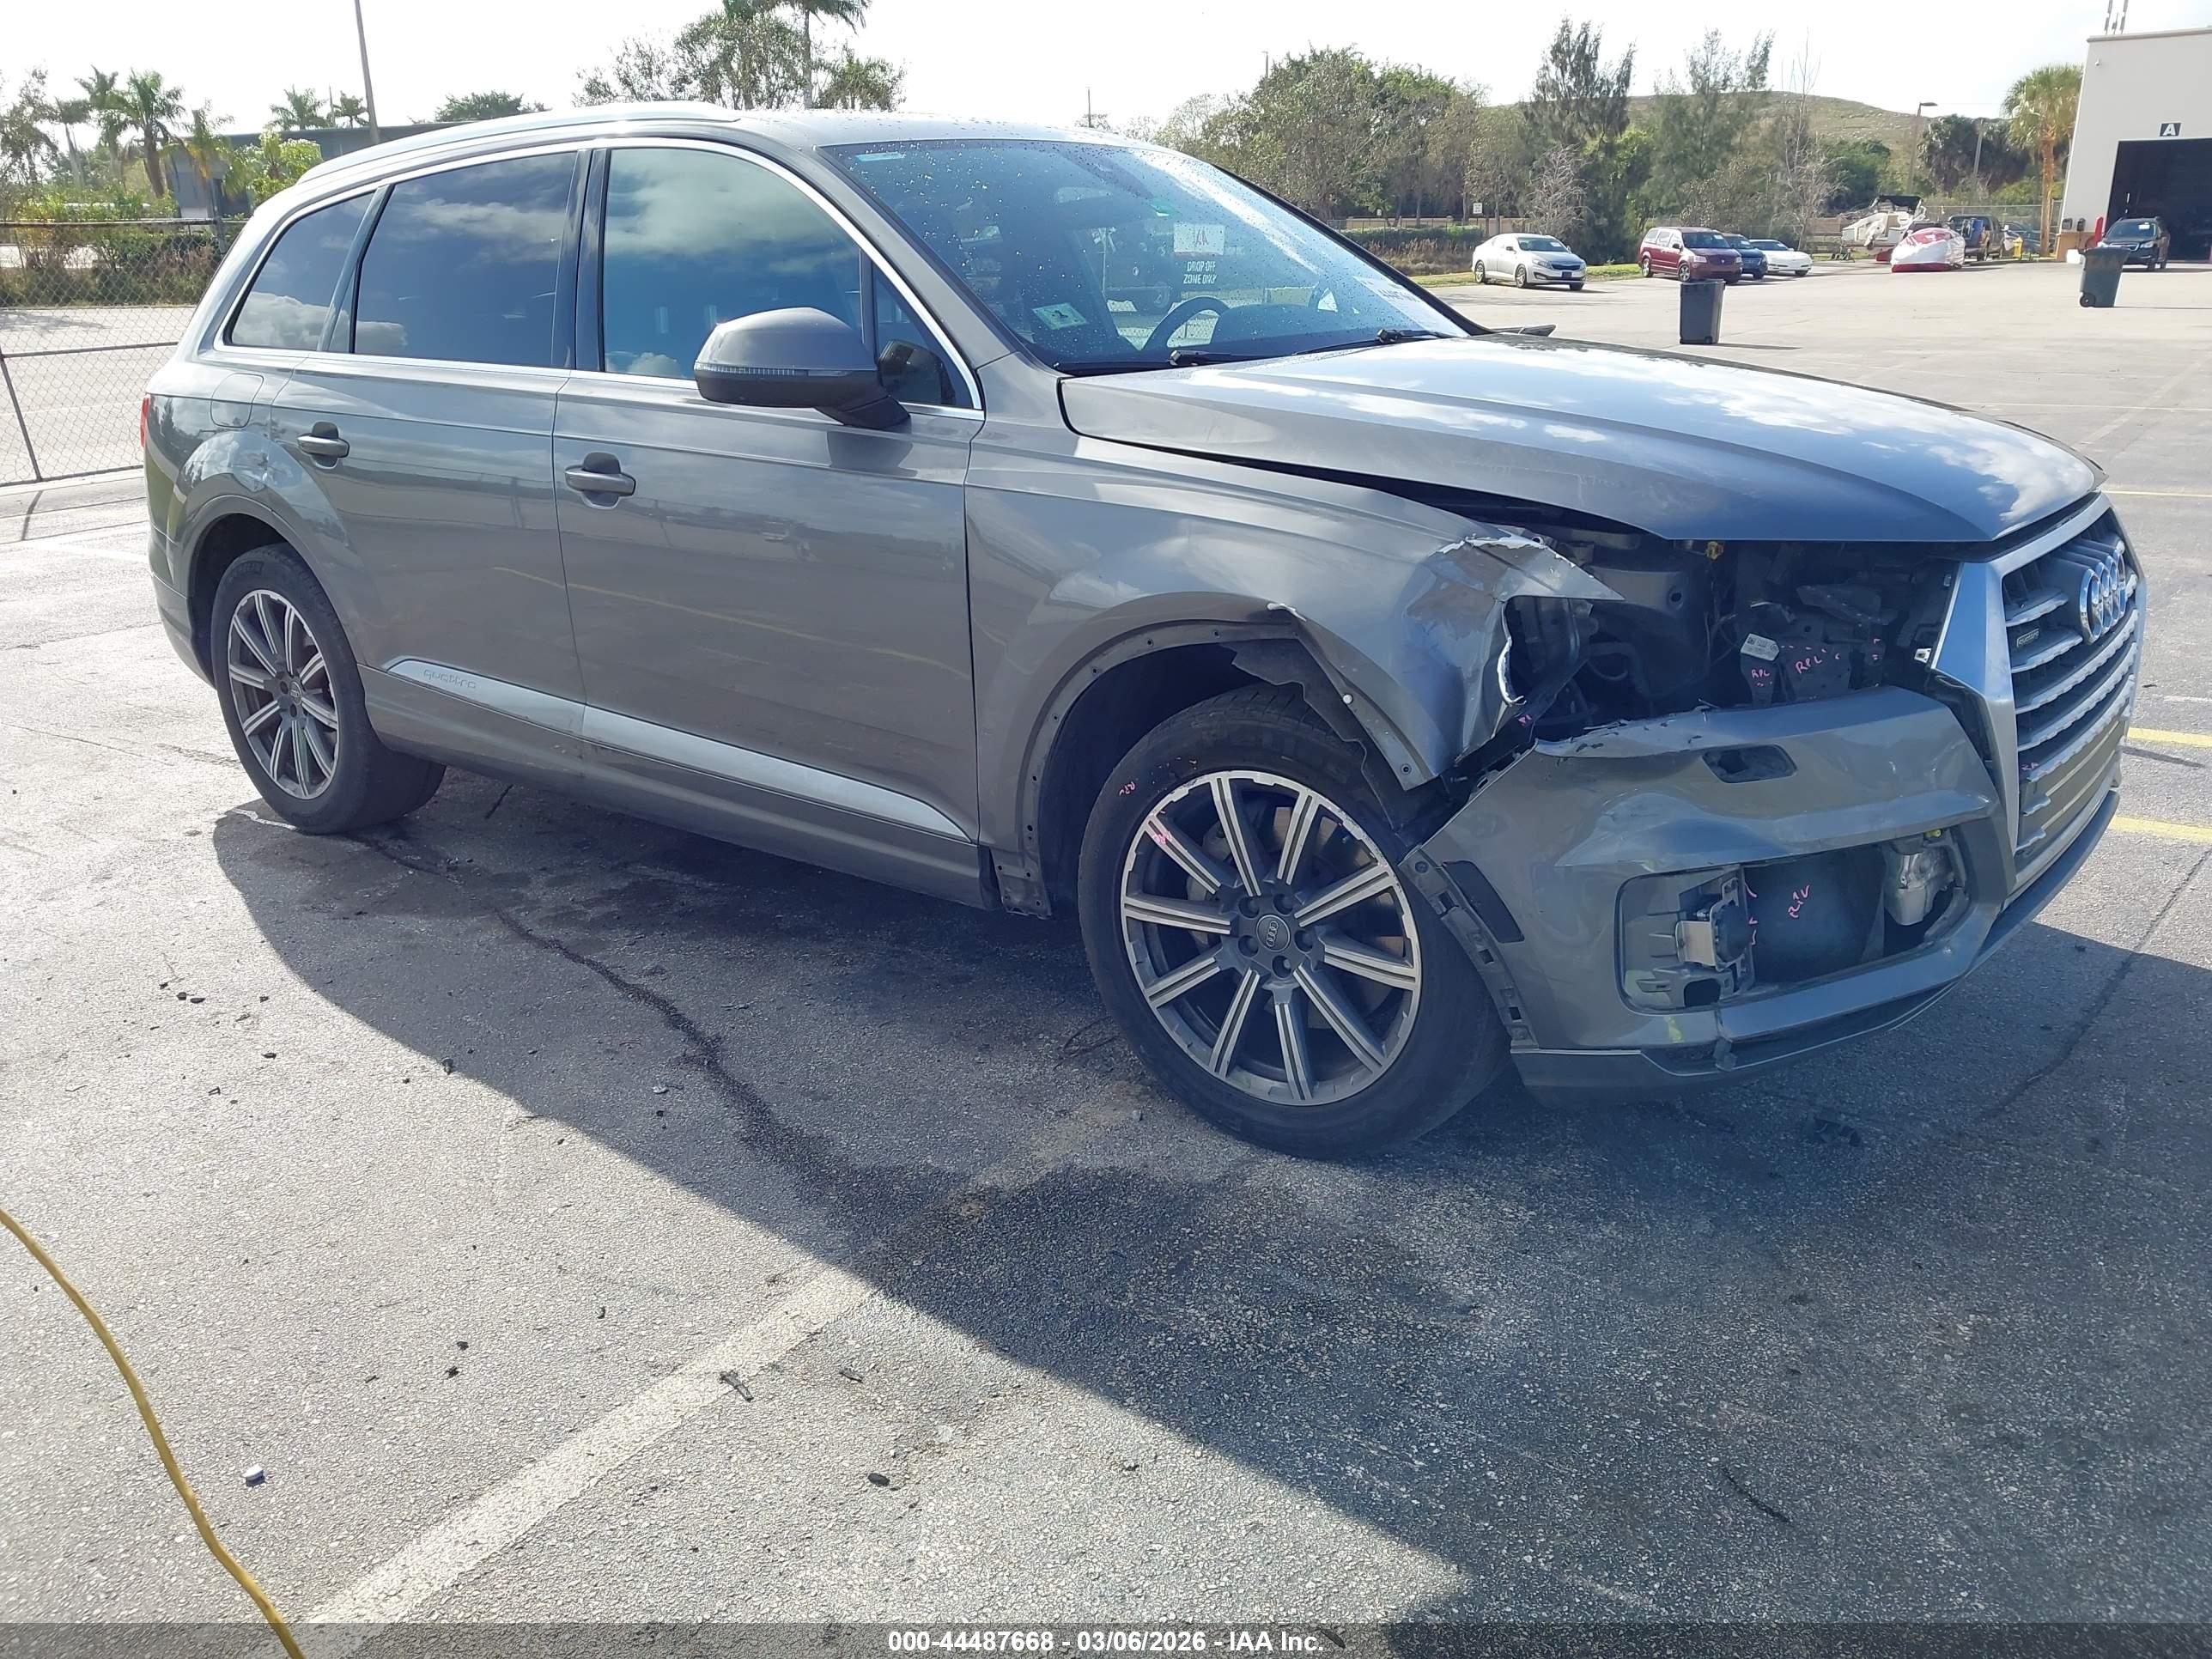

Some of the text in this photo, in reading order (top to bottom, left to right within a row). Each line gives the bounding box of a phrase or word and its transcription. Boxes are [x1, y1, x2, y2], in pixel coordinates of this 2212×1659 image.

[2162, 123, 2176, 137] A
[1183, 274, 1217, 284] ZONE ONLY
[1795, 655, 1823, 674] RPL
[423, 668, 477, 689] quattro
[1751, 669, 1771, 679] RPL
